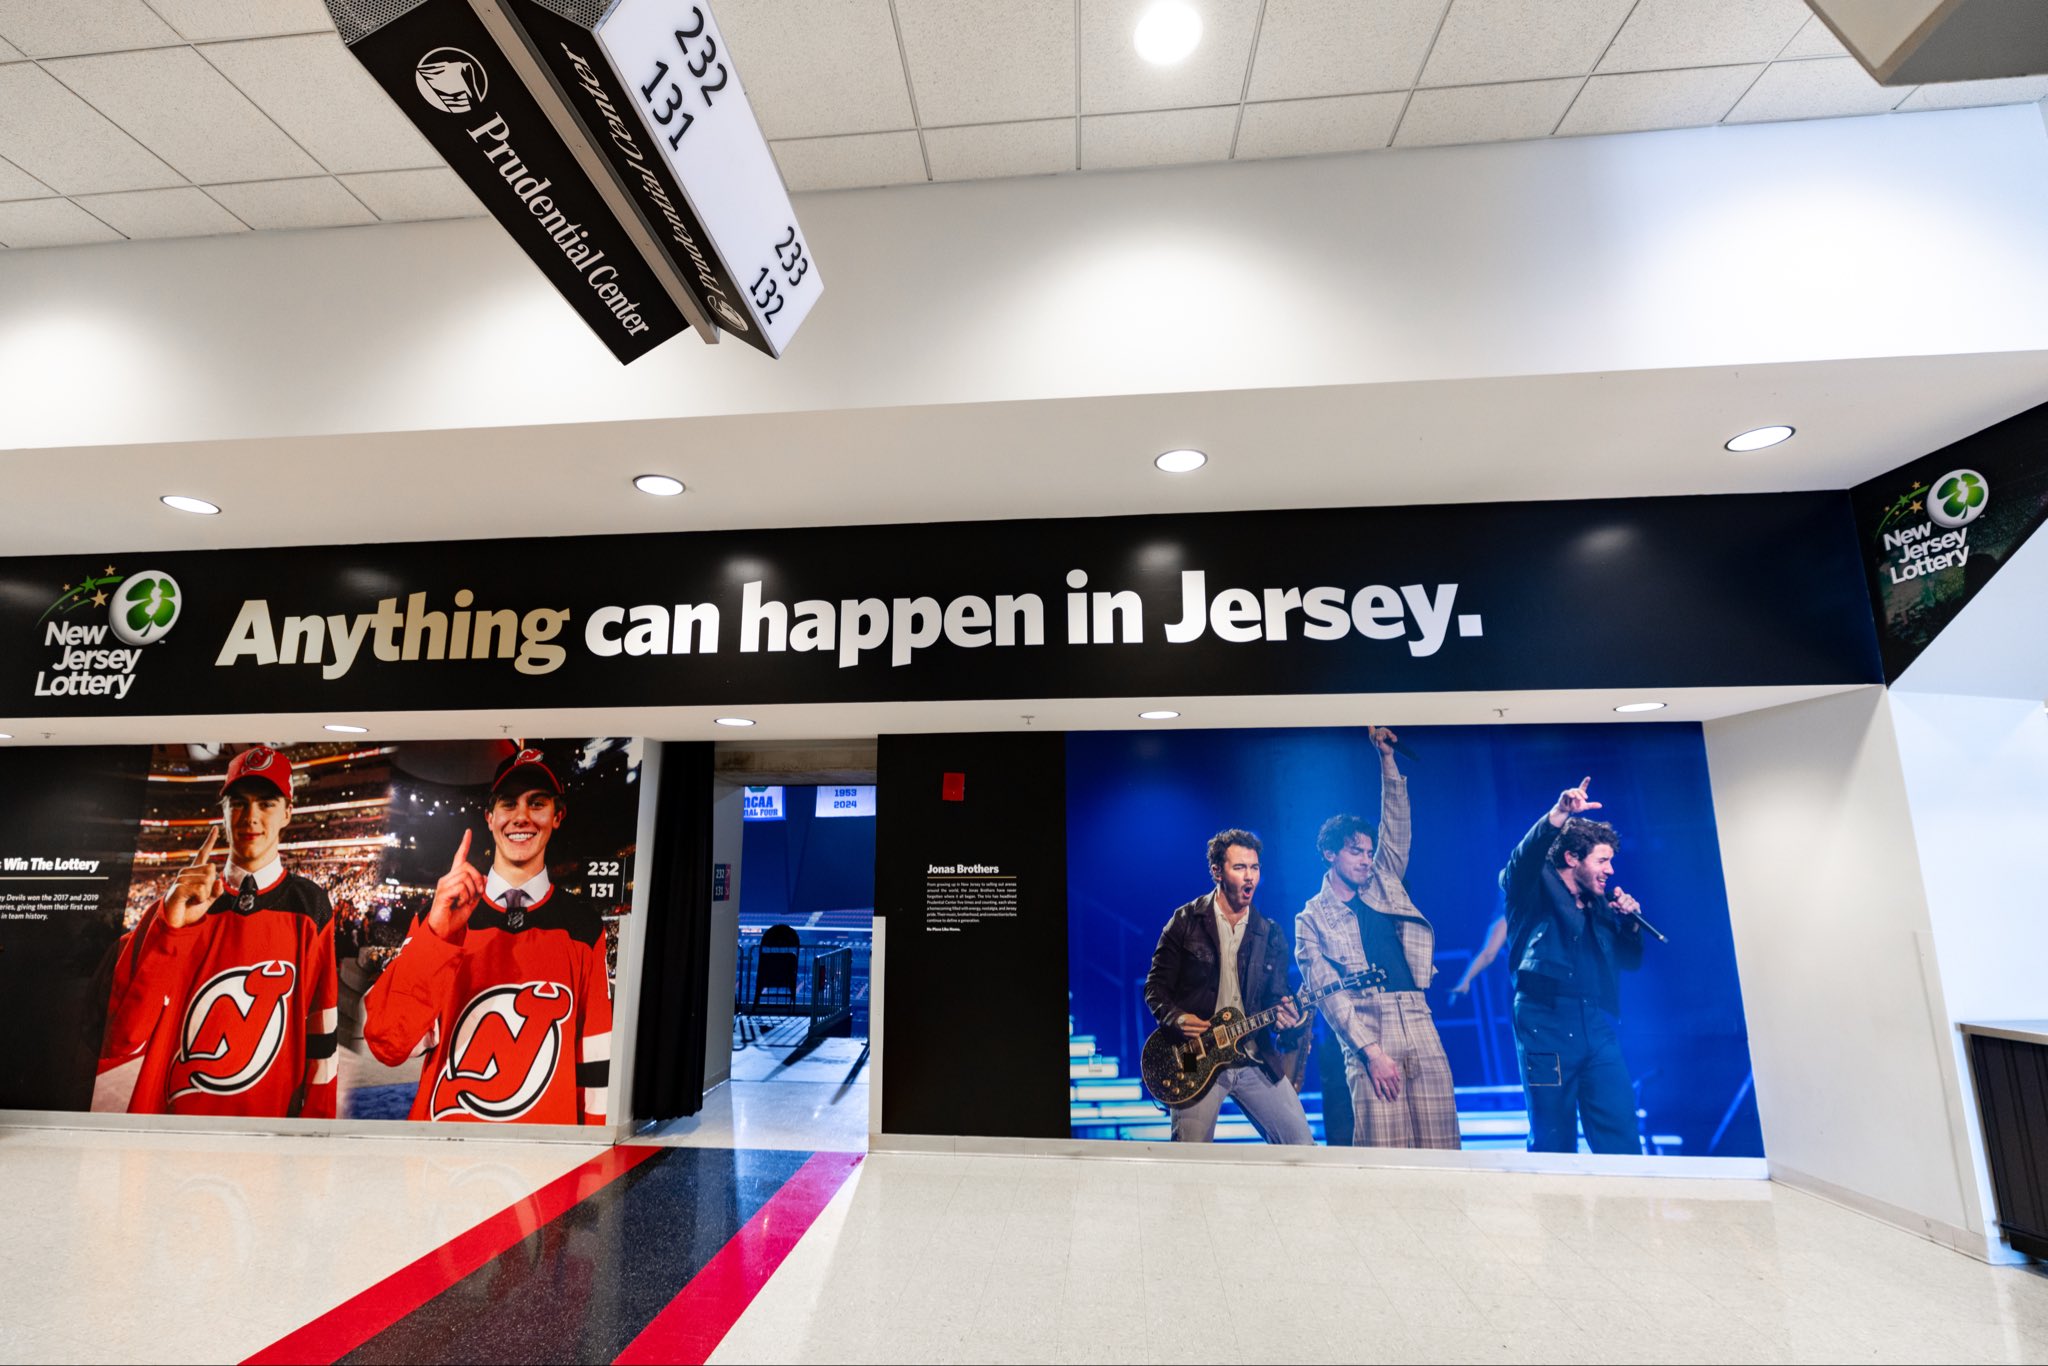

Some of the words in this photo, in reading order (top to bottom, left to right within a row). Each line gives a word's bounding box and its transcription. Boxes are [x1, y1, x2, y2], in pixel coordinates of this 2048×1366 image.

[675, 5, 727, 107] 232
[560, 42, 644, 162] Center
[641, 61, 695, 152] 131
[466, 112, 604, 272] Prudential
[588, 265, 650, 337] Center
[626, 159, 728, 299] Prudential
[775, 226, 809, 287] 233
[750, 267, 784, 325] 132
[1883, 521, 1932, 551] New
[1898, 527, 1968, 564] Jersey
[1890, 545, 1970, 585] Lottery
[44, 620, 109, 647] New
[215, 589, 570, 680] Anything
[584, 604, 720, 657] can
[739, 580, 1045, 668] happen
[1066, 568, 1144, 645] in
[1164, 570, 1484, 657] Jersey.
[52, 645, 143, 675] Jersey
[34, 670, 136, 700] Lottery
[834, 788, 857, 797] 1953
[834, 800, 857, 809] 2024
[4, 857, 29, 871] Win
[31, 857, 53, 871] The
[54, 857, 99, 873] Lottery
[587, 861, 620, 876] 232
[927, 864, 956, 874] Jonas
[957, 864, 1000, 874] Brothers
[589, 883, 614, 898] 131
[0, 903, 16, 911] eries,
[17, 904, 36, 912] giving
[26, 912, 48, 920] history.
